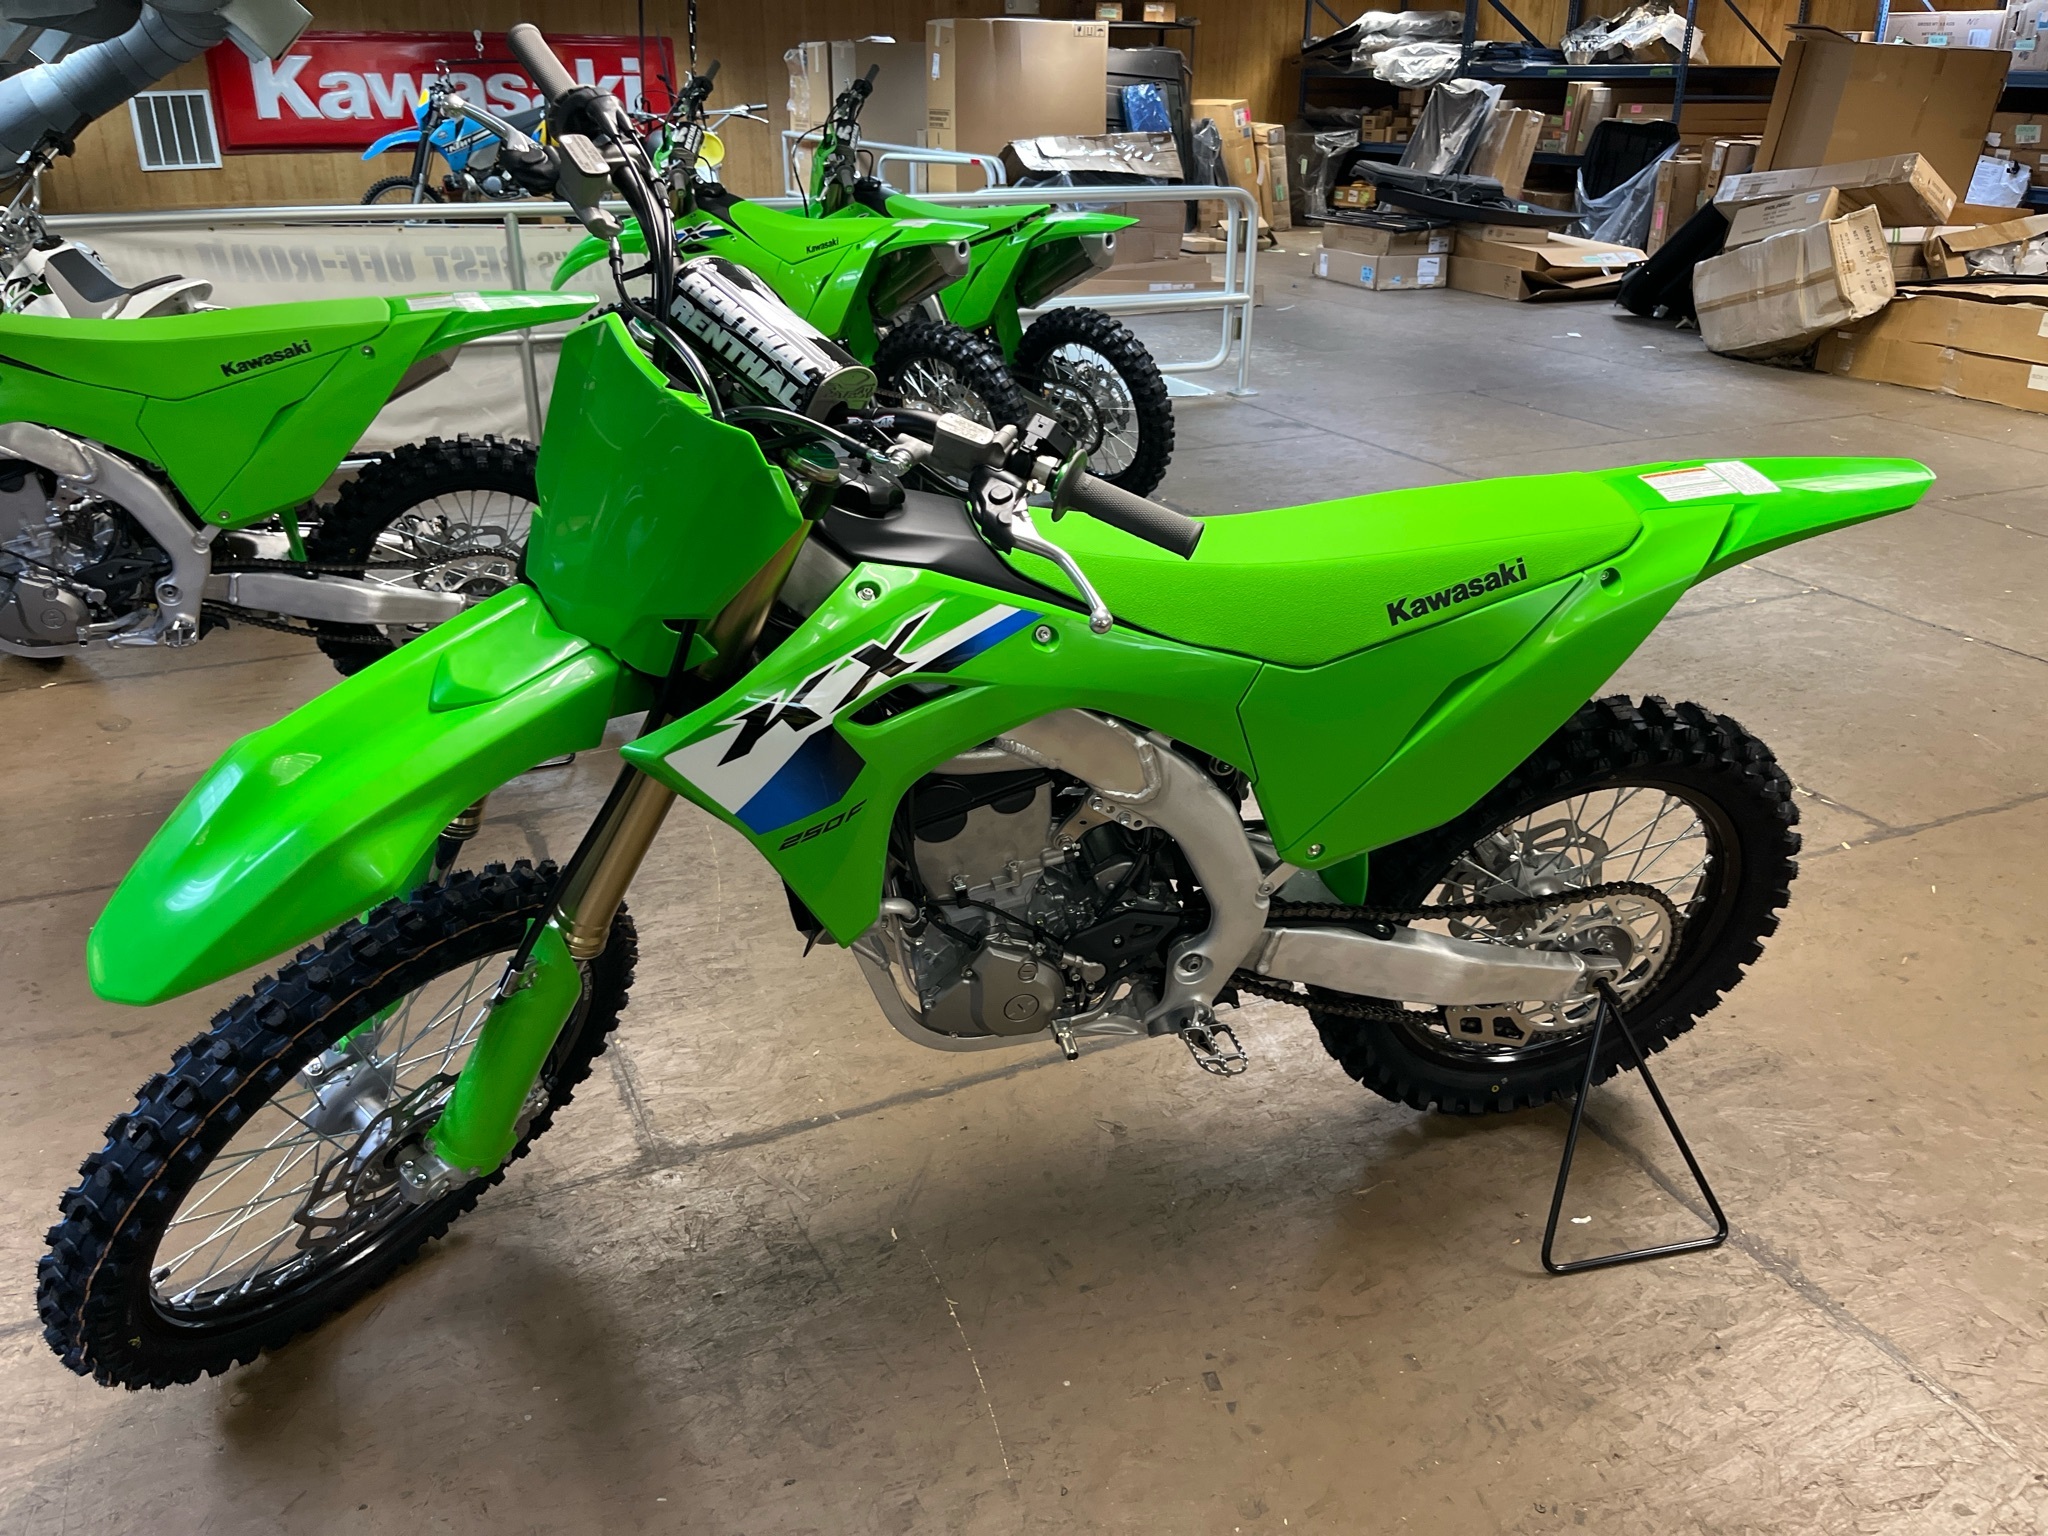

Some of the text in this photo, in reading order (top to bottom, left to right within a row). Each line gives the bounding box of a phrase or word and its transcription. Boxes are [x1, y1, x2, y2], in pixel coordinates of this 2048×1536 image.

[250, 55, 642, 121] Kawaski
[806, 236, 839, 254] Kawasaki
[220, 339, 312, 377] Kawasaki
[670, 296, 799, 411] RENTHAL
[678, 271, 818, 386] RENTHAL
[1386, 557, 1528, 627] Kawasaki
[778, 798, 868, 851] 250F
